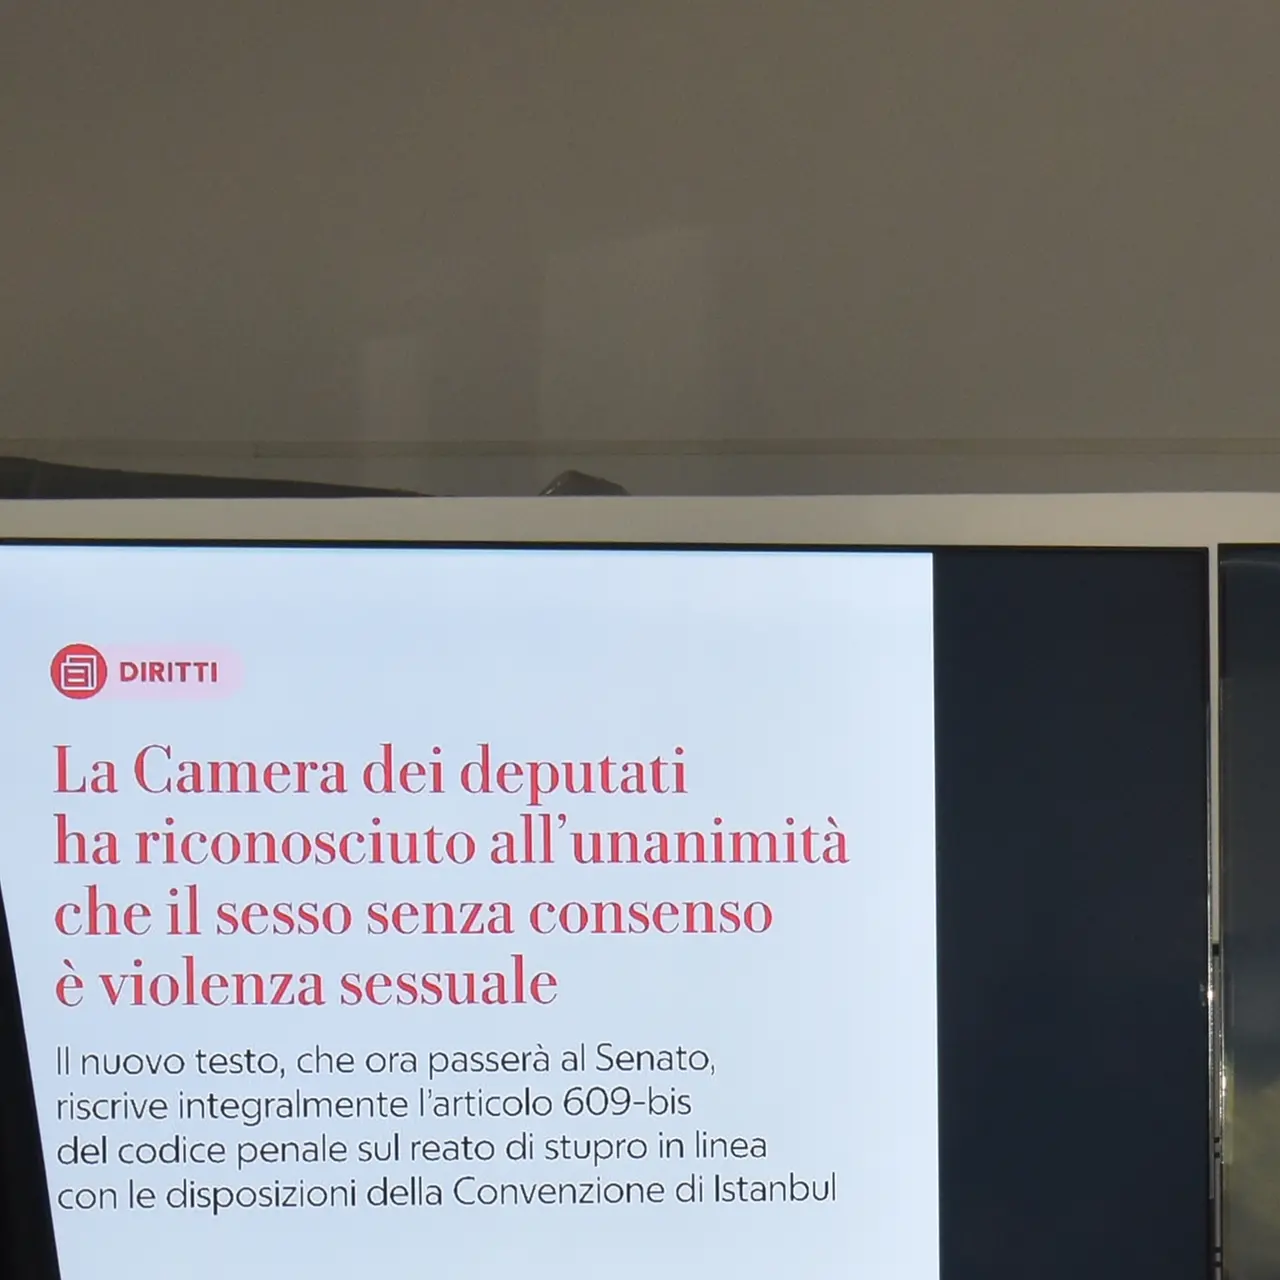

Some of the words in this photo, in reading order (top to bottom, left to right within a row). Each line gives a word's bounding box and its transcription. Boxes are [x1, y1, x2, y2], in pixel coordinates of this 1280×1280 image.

[119, 661, 218, 683] DIRITTI
[53, 745, 119, 794] La
[134, 744, 349, 794] Camera
[362, 743, 445, 794] dei
[460, 743, 688, 807] deputati
[53, 813, 121, 865] ha
[135, 816, 476, 865] riconosciuto
[54, 883, 152, 936] che
[166, 883, 202, 935] il
[216, 902, 352, 935] sesso
[367, 901, 515, 935] senza
[529, 901, 773, 935] consenso
[55, 958, 84, 1008] è
[98, 955, 326, 1007] violenza
[340, 953, 558, 1006] sessuale
[57, 1045, 70, 1076] Il
[81, 1053, 186, 1076] nuovo
[195, 1049, 285, 1079] testo,
[297, 1044, 355, 1074] che
[365, 1052, 417, 1073] ora
[429, 1043, 550, 1081] passerà
[561, 1042, 585, 1072] al
[595, 1042, 715, 1076] Senato,
[57, 1091, 169, 1121] riscrive
[179, 1088, 409, 1127] integralmente
[563, 1085, 692, 1116] 609-bis
[57, 1135, 107, 1166] del
[118, 1134, 226, 1165] codice
[237, 1132, 348, 1171] penale
[358, 1132, 400, 1163] sul
[411, 1135, 495, 1162] reato
[505, 1131, 534, 1161] di
[544, 1134, 648, 1168] stupro
[658, 1131, 684, 1159] in
[695, 1129, 767, 1159] linea
[57, 1188, 117, 1210] con
[129, 1178, 156, 1209] le
[166, 1178, 356, 1216] disposizioni
[366, 1175, 442, 1207] della
[453, 1175, 665, 1205] Convenzione
[675, 1172, 703, 1203] di
[714, 1171, 836, 1203] Istanbul
